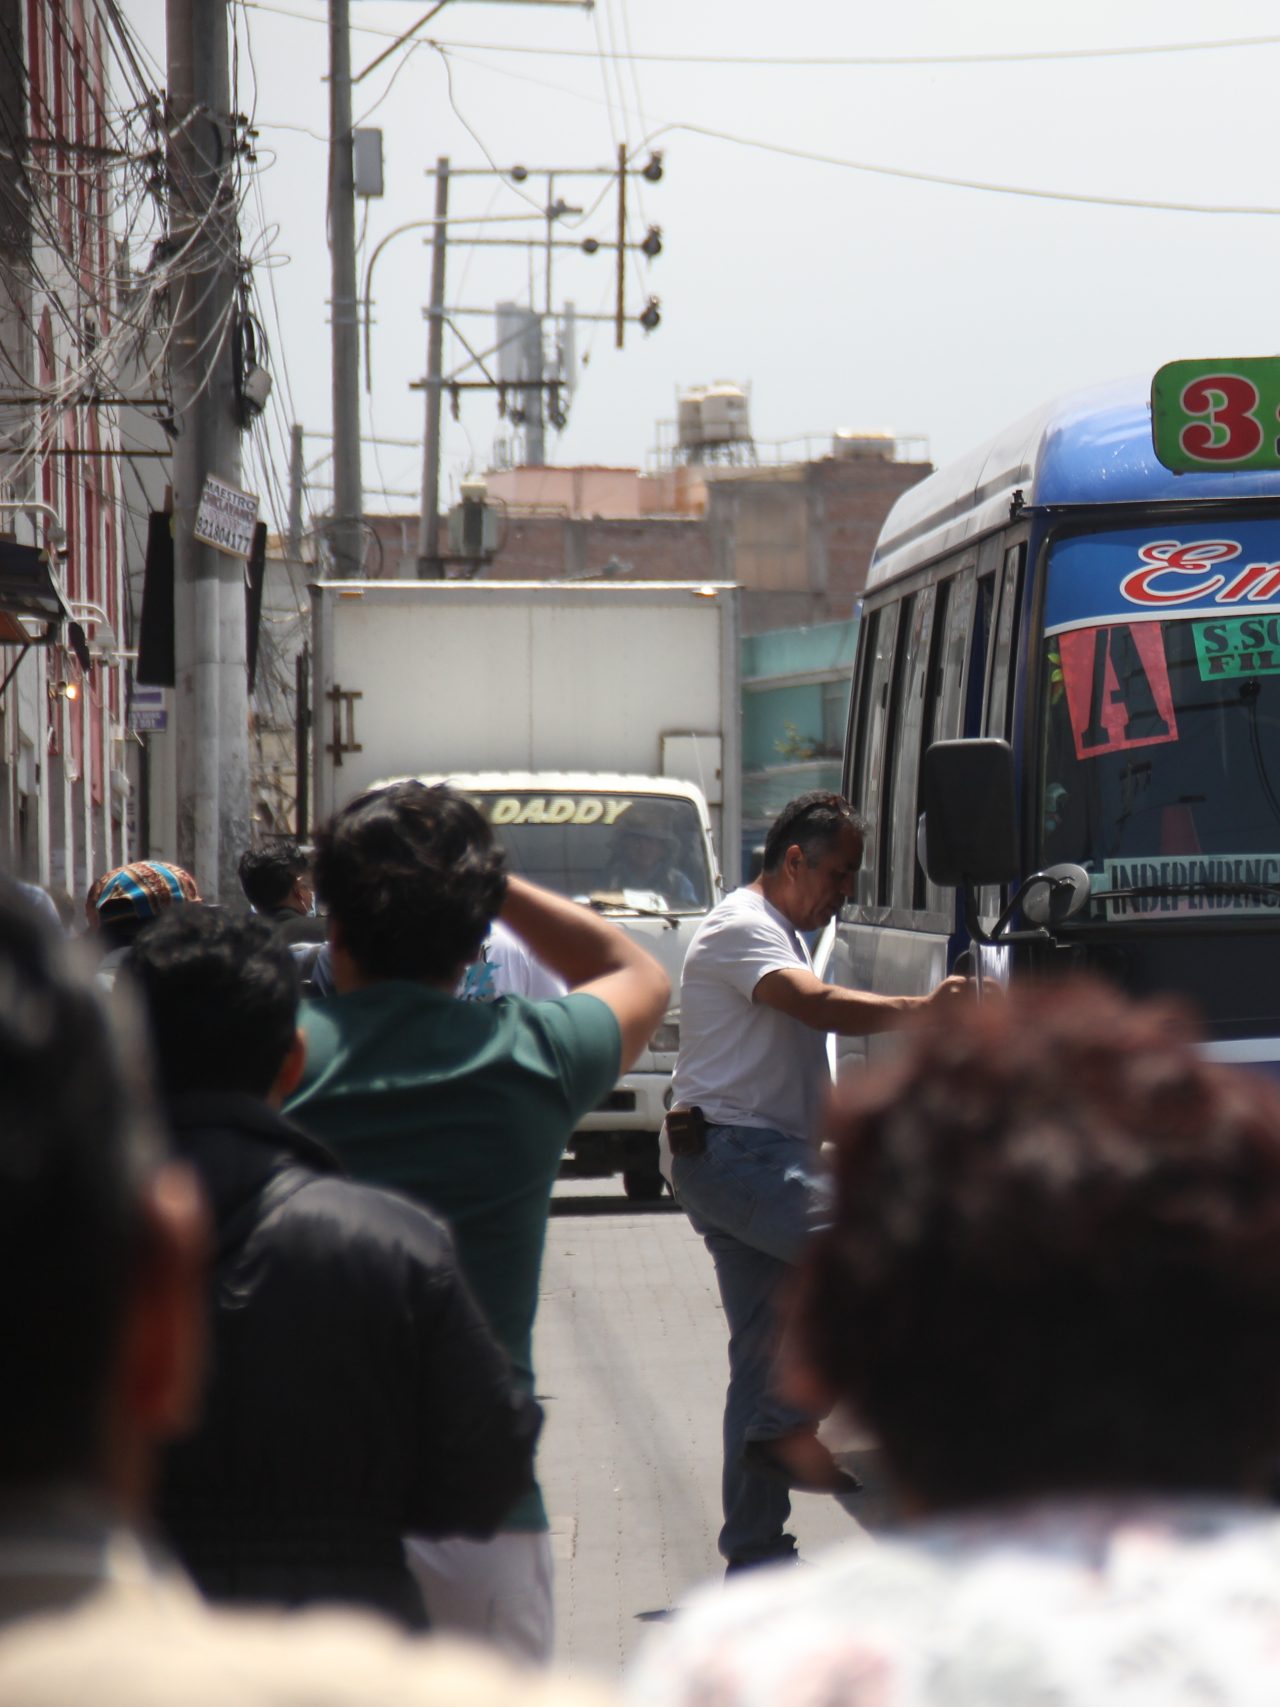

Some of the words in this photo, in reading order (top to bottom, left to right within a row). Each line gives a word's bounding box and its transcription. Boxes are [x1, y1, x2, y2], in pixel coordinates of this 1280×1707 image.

[1180, 374, 1262, 461] 3
[1081, 625, 1171, 749] A
[490, 797, 633, 825] DADDY
